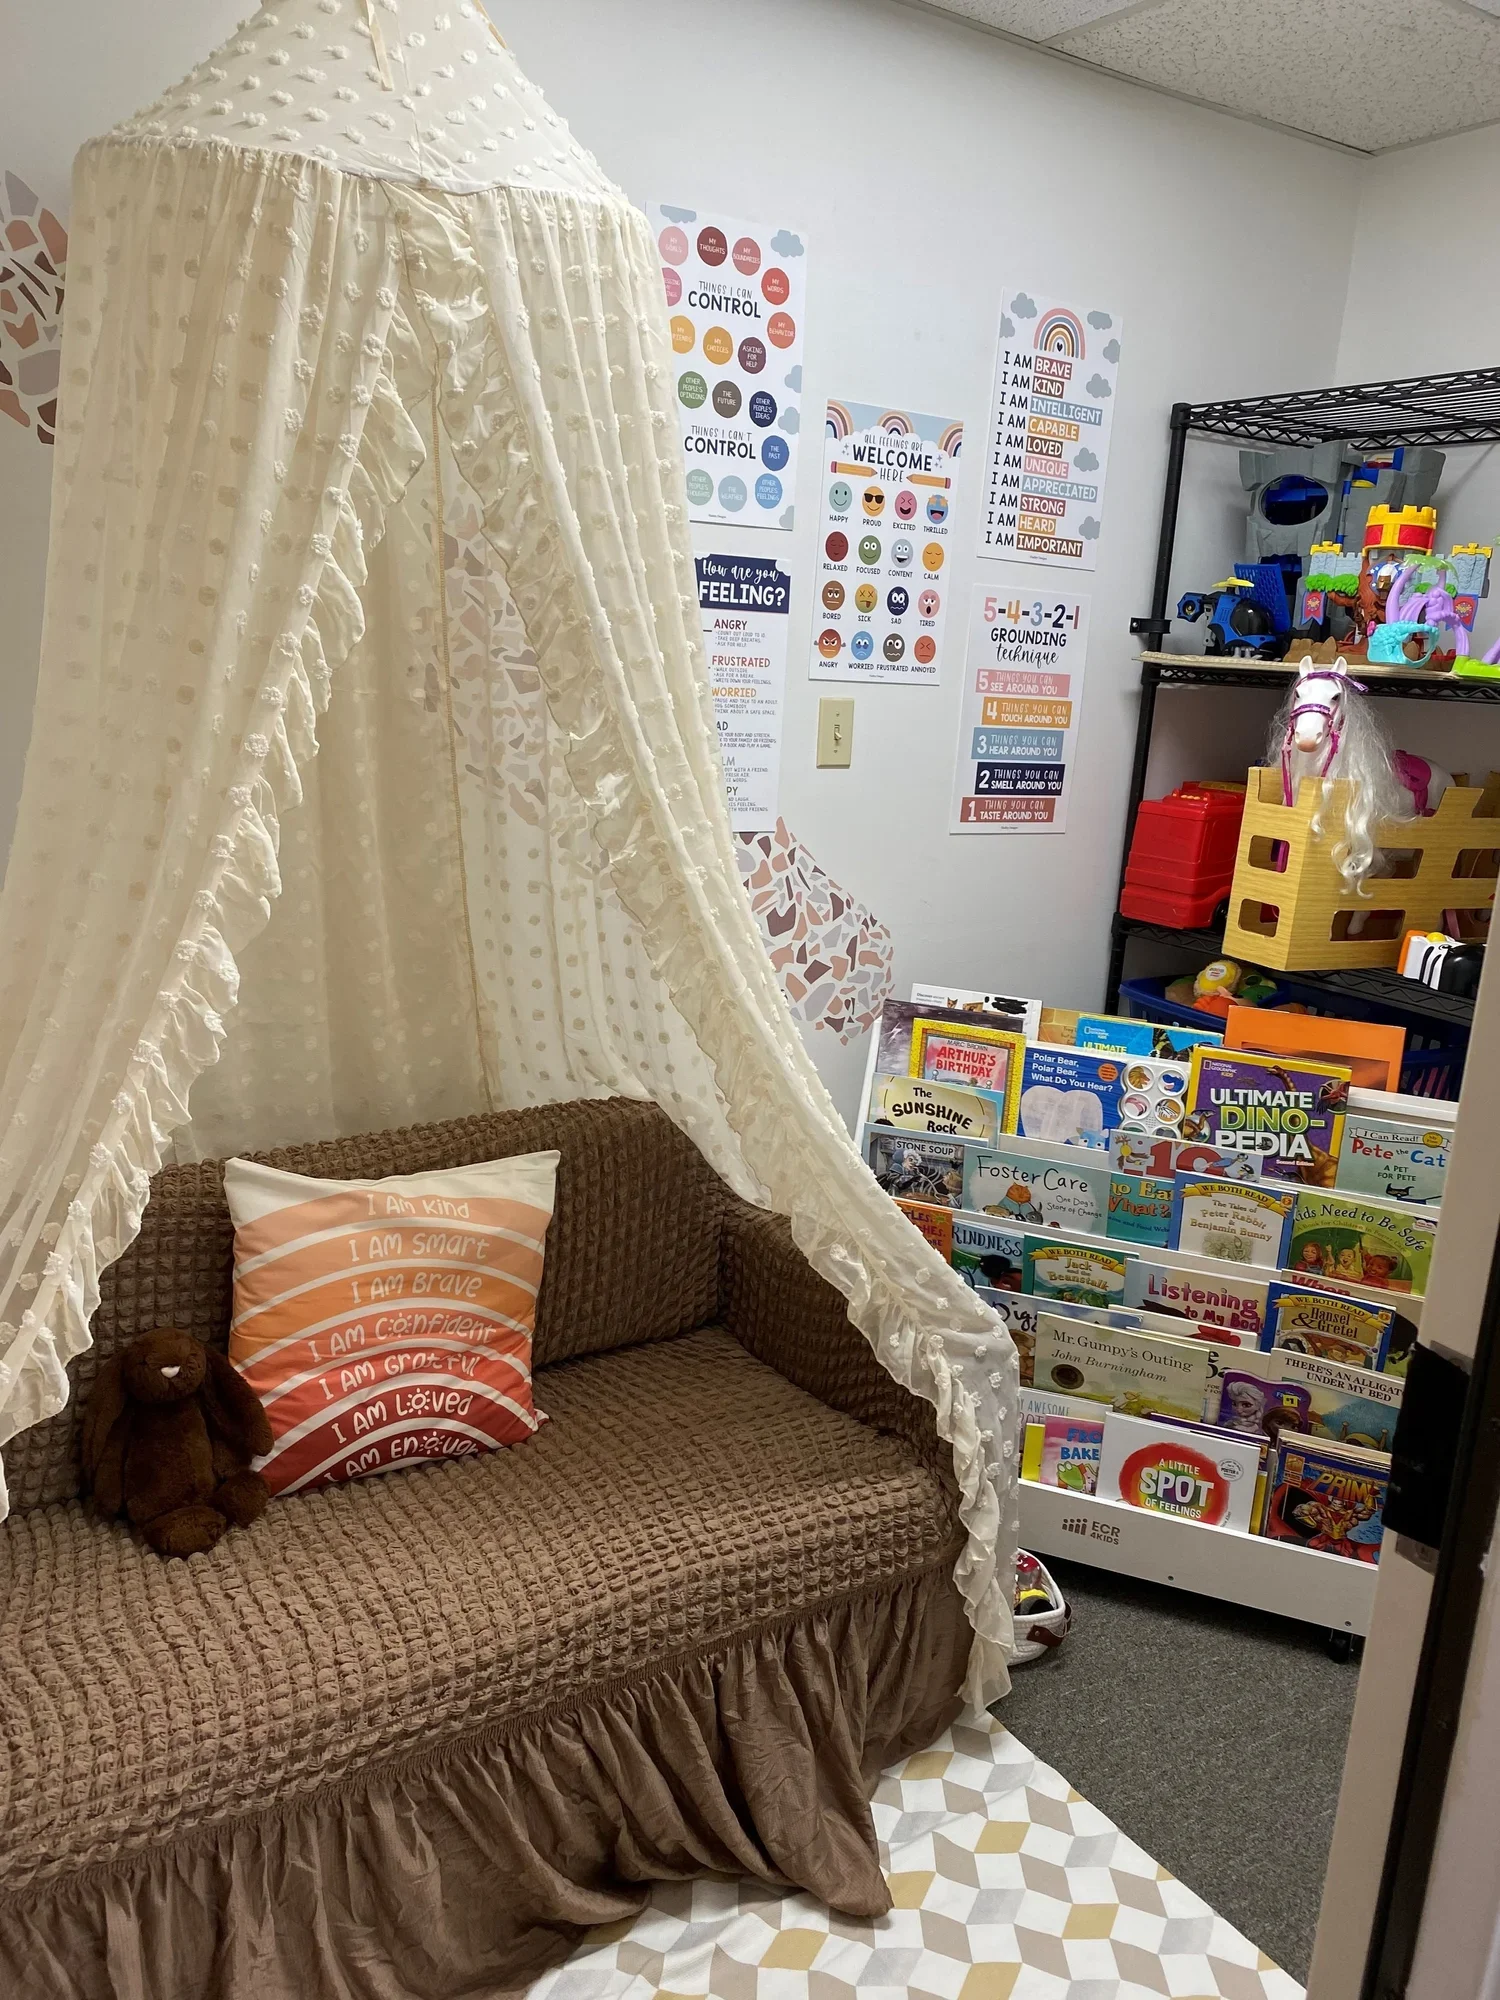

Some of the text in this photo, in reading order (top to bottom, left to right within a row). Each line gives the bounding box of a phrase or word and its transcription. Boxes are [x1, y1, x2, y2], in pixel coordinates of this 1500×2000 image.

[700, 243, 725, 254] THOUGHTS
[688, 291, 761, 318] CONTROL
[743, 346, 763, 354] ASKING
[1004, 351, 1071, 378] I AM BRAVE
[1002, 372, 1062, 395] I AM KIND
[1000, 392, 1101, 423] I AM INTELLIGENT
[684, 437, 756, 460] CONTROL
[996, 432, 1061, 455] I AM LOVED
[853, 444, 932, 471] WELCOME
[880, 470, 904, 483] HERE
[991, 472, 1095, 500] I AM APPRECIATED
[989, 492, 1064, 514] I AM STRONG
[829, 515, 848, 523] HAPPY
[863, 519, 881, 527] PROUD
[893, 522, 916, 531] EXCITED
[923, 526, 948, 534] THRILLED
[985, 531, 1082, 556] I AM IMPORTANT
[703, 560, 778, 584] How are you
[823, 563, 848, 572] RELAXED
[856, 566, 880, 575] FOCUSED
[888, 570, 913, 578] CONTENT
[924, 572, 939, 580] CALM
[699, 581, 785, 607] FEELING?
[823, 612, 841, 620] BORED
[984, 597, 1080, 629] 5-4-3-2-1
[714, 619, 747, 630] ANGRY
[991, 628, 1066, 647] GROUNDING
[712, 656, 770, 667] FRUSTRATED
[819, 661, 838, 669] ANGRY
[996, 643, 1059, 669] technique
[877, 664, 908, 672] FRUSTRATED
[911, 666, 936, 674] ANNOYED
[979, 672, 989, 690] 5
[990, 683, 1058, 695] SEE AROUND YOU
[712, 687, 756, 697] WORRIED
[987, 701, 997, 719] 4
[1001, 714, 1068, 724] TOUCH AROUND YOU
[979, 770, 989, 789] 2
[991, 781, 1061, 790] SMELL AROUND YOU
[937, 1046, 996, 1066] ARTHUR'S
[1033, 1053, 1079, 1068] Polar Bear,
[936, 1060, 993, 1077] BIRTHDAY
[1032, 1063, 1078, 1078] Polar Bear,
[913, 1087, 932, 1098] The
[1031, 1073, 1113, 1093] What Do You Hear?
[1210, 1088, 1312, 1108] ULTIMATE
[892, 1102, 973, 1130] SUNSHINE
[1221, 1106, 1324, 1133] DINO-
[927, 1121, 957, 1135] Rock
[1392, 1134, 1419, 1142] Read!
[896, 1141, 953, 1156] STONE SOUP
[1215, 1130, 1312, 1159] PEDIA
[1352, 1139, 1393, 1159] Pete
[1410, 1150, 1445, 1167] Cat
[977, 1155, 1088, 1192] Foster Care
[1378, 1172, 1394, 1180] FOR
[368, 1194, 375, 1215] I
[1201, 1209, 1267, 1229] Peter Rabbit
[1321, 1204, 1358, 1218] Need
[1361, 1212, 1374, 1223] to
[1378, 1216, 1396, 1231] Be
[1398, 1229, 1424, 1251] Safe
[1190, 1219, 1272, 1241] Benjamin Bunny
[350, 1240, 359, 1261] I
[369, 1236, 402, 1256] AM
[952, 1226, 1022, 1256] KINDNESS
[1065, 1258, 1092, 1271] Jack
[353, 1282, 361, 1303] I
[370, 1276, 402, 1300] AM
[1048, 1272, 1109, 1291] Beanstalk
[1148, 1274, 1258, 1319] Listening
[1184, 1306, 1198, 1319] to
[1202, 1310, 1224, 1326] My
[1296, 1297, 1365, 1317] WE BOTH READ
[1310, 1307, 1350, 1326] Hansel
[1291, 1313, 1358, 1339] & Gretel
[308, 1341, 321, 1362] I
[330, 1327, 365, 1354] AM
[1053, 1330, 1075, 1343] Mr.
[1078, 1335, 1138, 1358] Gumpy's
[1142, 1350, 1194, 1375] Outing
[1052, 1350, 1167, 1382] John Burningham
[1285, 1357, 1333, 1376] THERE'S
[1335, 1370, 1350, 1380] AN
[1307, 1373, 1391, 1402] UNDER MY BED
[331, 1423, 346, 1444] I
[353, 1403, 386, 1433] AM
[1159, 1459, 1200, 1476] A LITTLE
[1139, 1467, 1214, 1508] SPOT
[1145, 1498, 1201, 1519] OF FEELINGS
[1090, 1531, 1119, 1545] 4KIDS
[1092, 1521, 1121, 1538] ECR
